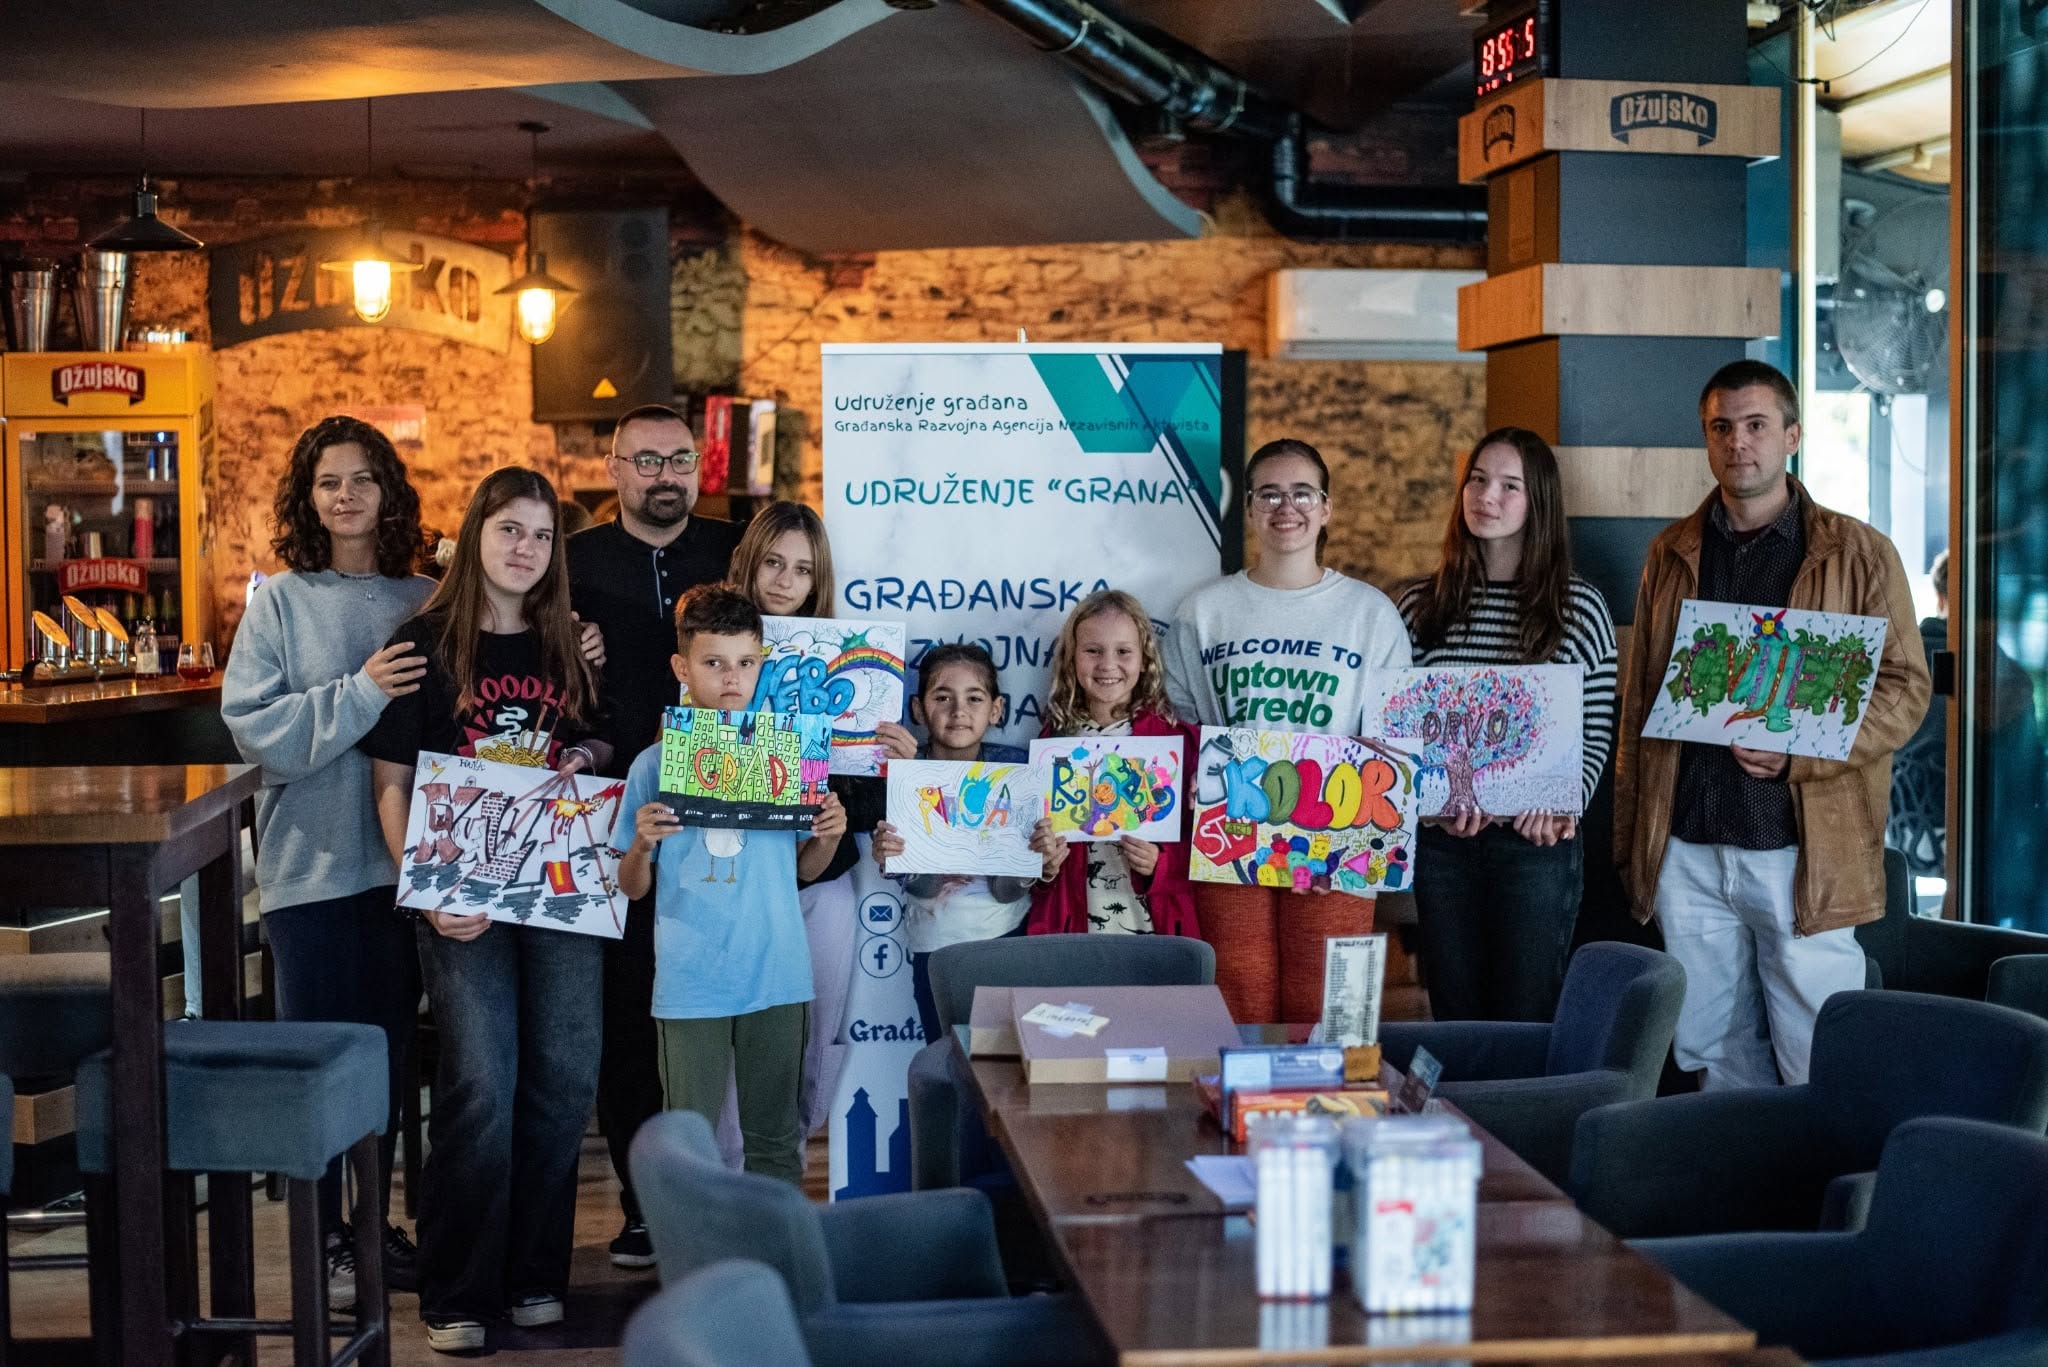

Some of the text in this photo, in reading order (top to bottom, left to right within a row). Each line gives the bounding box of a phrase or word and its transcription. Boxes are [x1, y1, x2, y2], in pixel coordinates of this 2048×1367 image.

[1620, 94, 1708, 127] Ožujsko
[60, 363, 139, 393] Ožujsko
[835, 392, 1028, 417] Udruženje građana
[834, 418, 913, 432] Građanska
[918, 418, 988, 435] Razvojna
[992, 418, 1054, 435] Agencija
[1059, 417, 1138, 432] Nezavisnih
[845, 472, 1034, 508] UDRUŽENJE
[66, 560, 140, 588] Ožujsko
[1200, 638, 1362, 670] WELCOME TO
[1212, 660, 1340, 696] Uptown
[1422, 709, 1508, 749] DRVO
[693, 746, 788, 798] GRAD
[1224, 755, 1401, 832] KOLOR
[1228, 823, 1251, 836] ART
